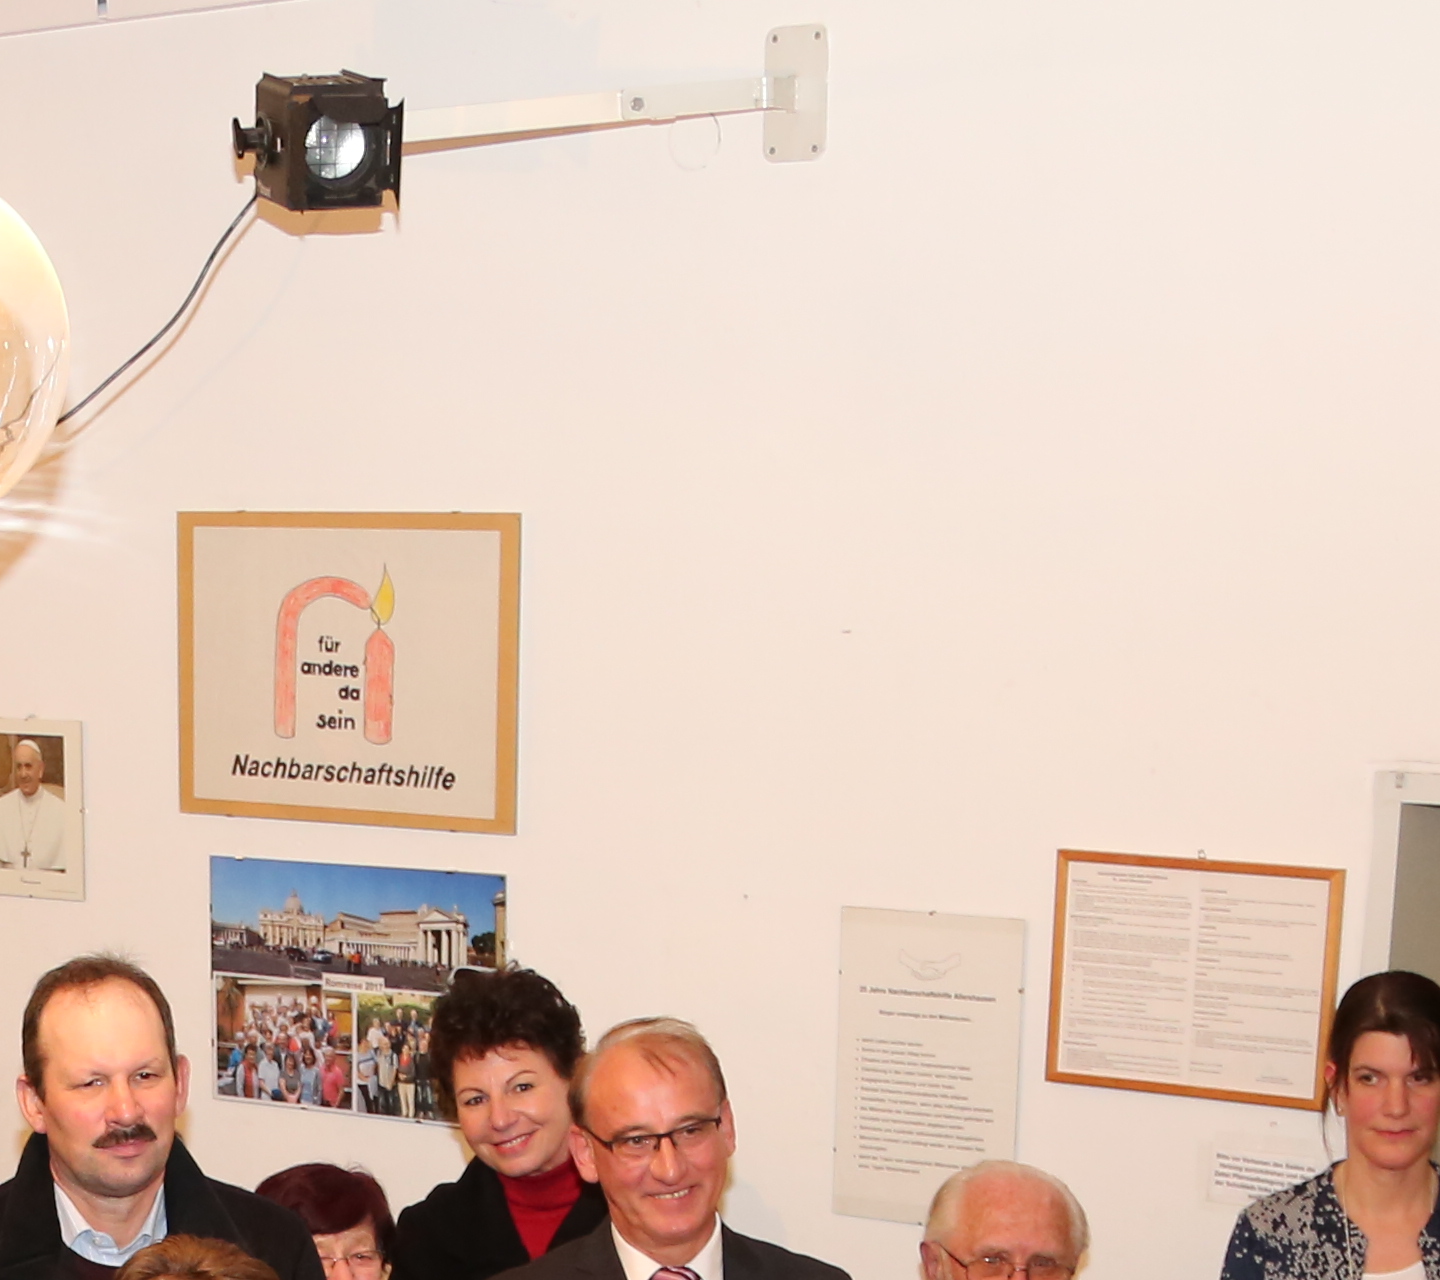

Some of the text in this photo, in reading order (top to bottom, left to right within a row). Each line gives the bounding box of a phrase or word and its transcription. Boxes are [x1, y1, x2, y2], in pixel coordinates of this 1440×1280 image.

[318, 635, 341, 653] für
[300, 660, 360, 678] andere
[338, 684, 361, 701] da
[316, 709, 356, 730] sein
[231, 754, 456, 791] Nachbarschaftshilfe
